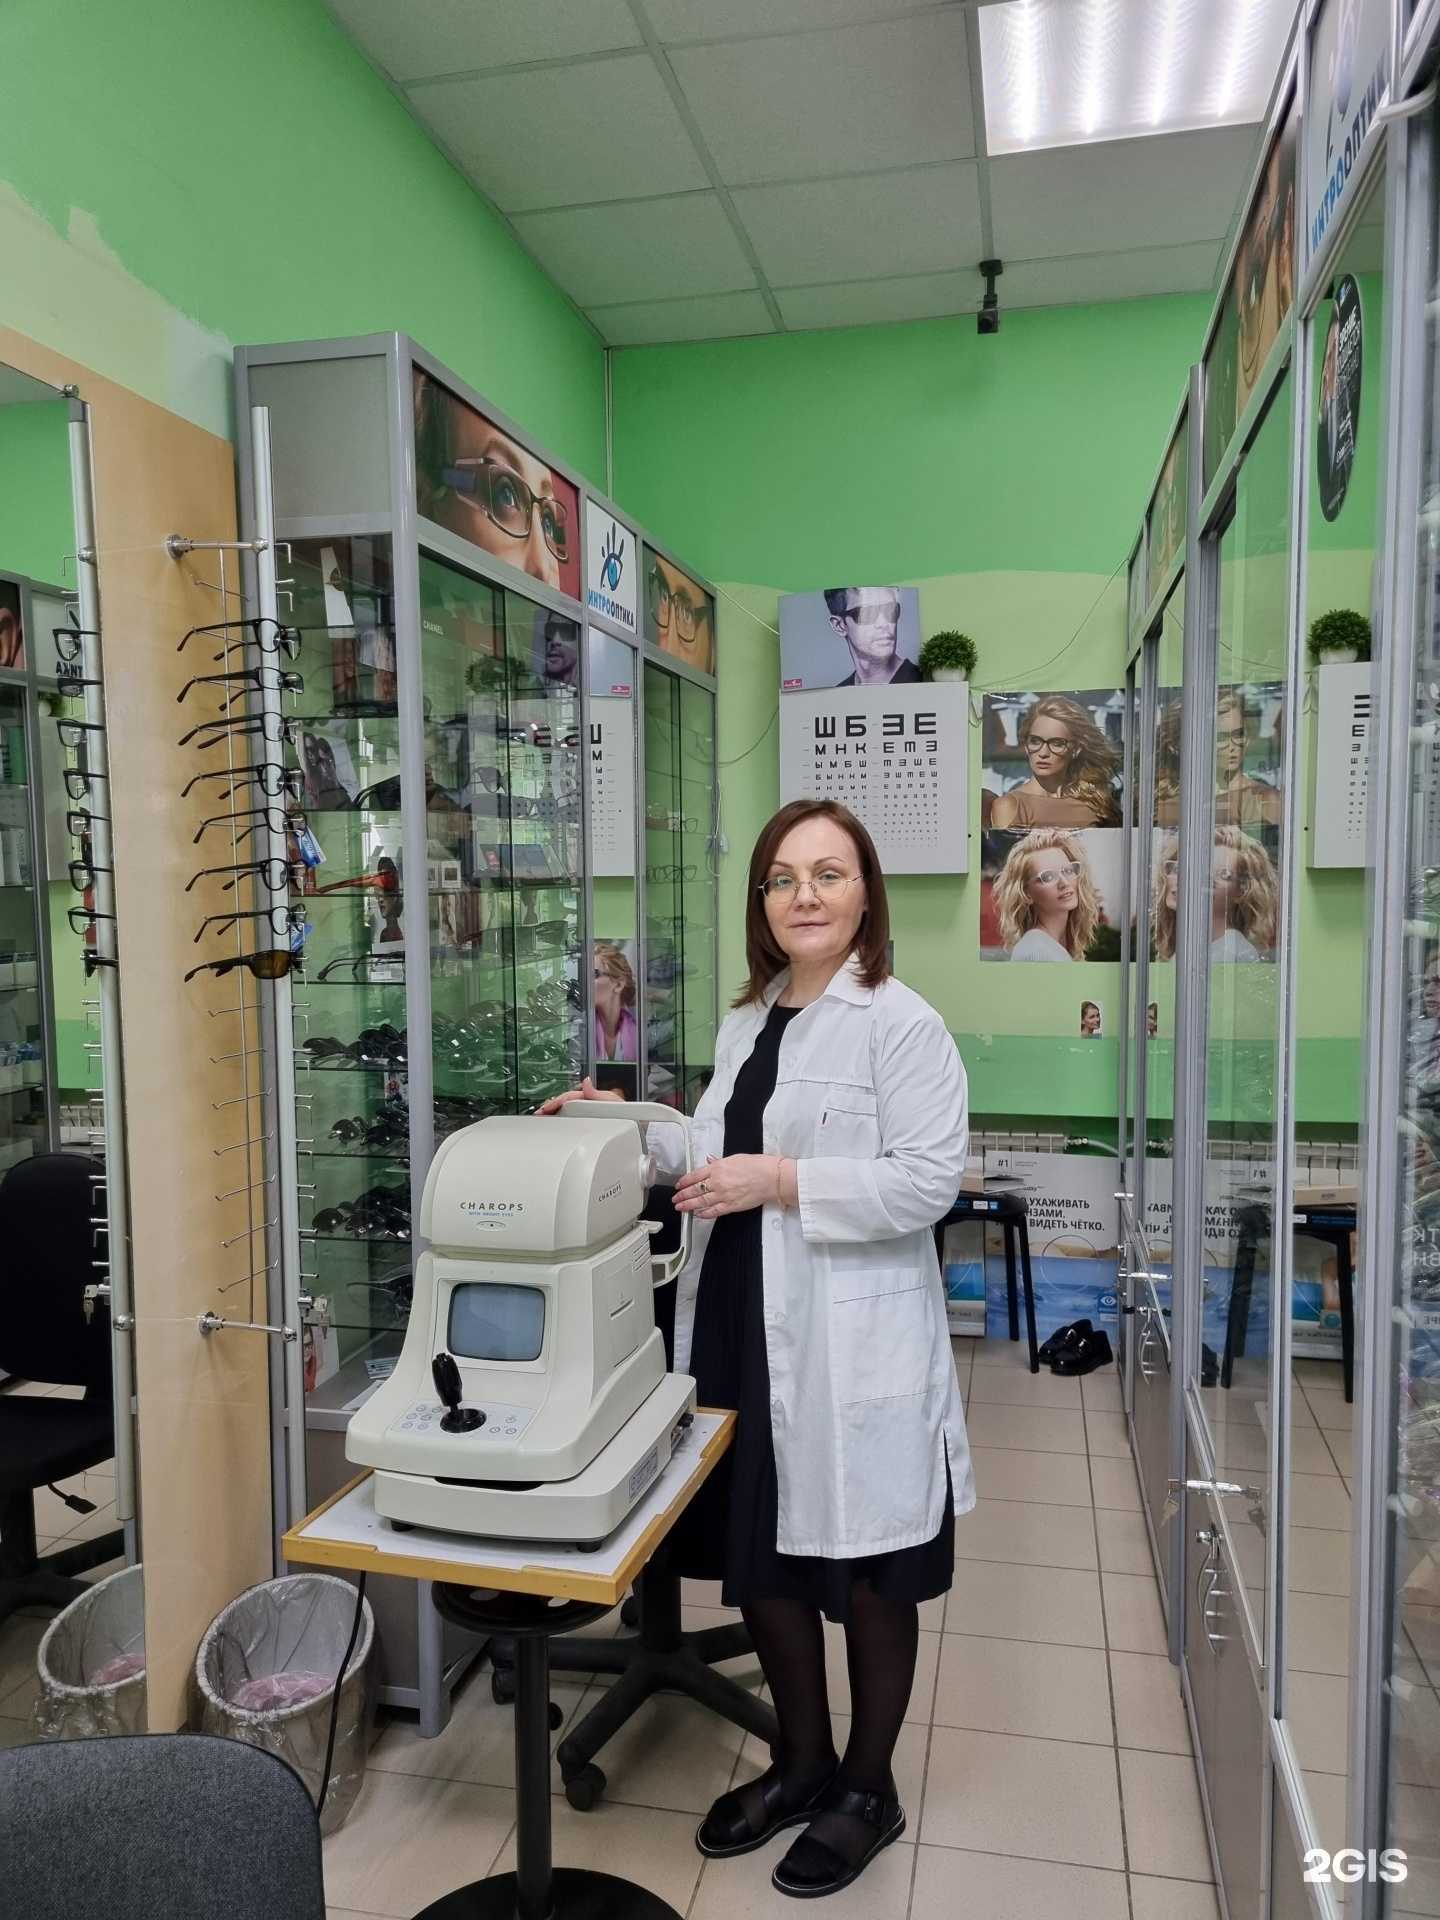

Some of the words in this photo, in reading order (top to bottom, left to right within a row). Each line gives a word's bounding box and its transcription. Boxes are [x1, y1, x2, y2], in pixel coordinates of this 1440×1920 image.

[588, 588, 634, 627] ИНТРООПТИКА
[997, 1160, 1009, 1168] #1
[459, 1201, 524, 1211] CHAROPS
[1030, 1197, 1091, 1209] УХАЖИВАТЬ
[1025, 1208, 1066, 1219] НЗАМИ.
[1029, 1218, 1068, 1231] ВИДЕТЬ
